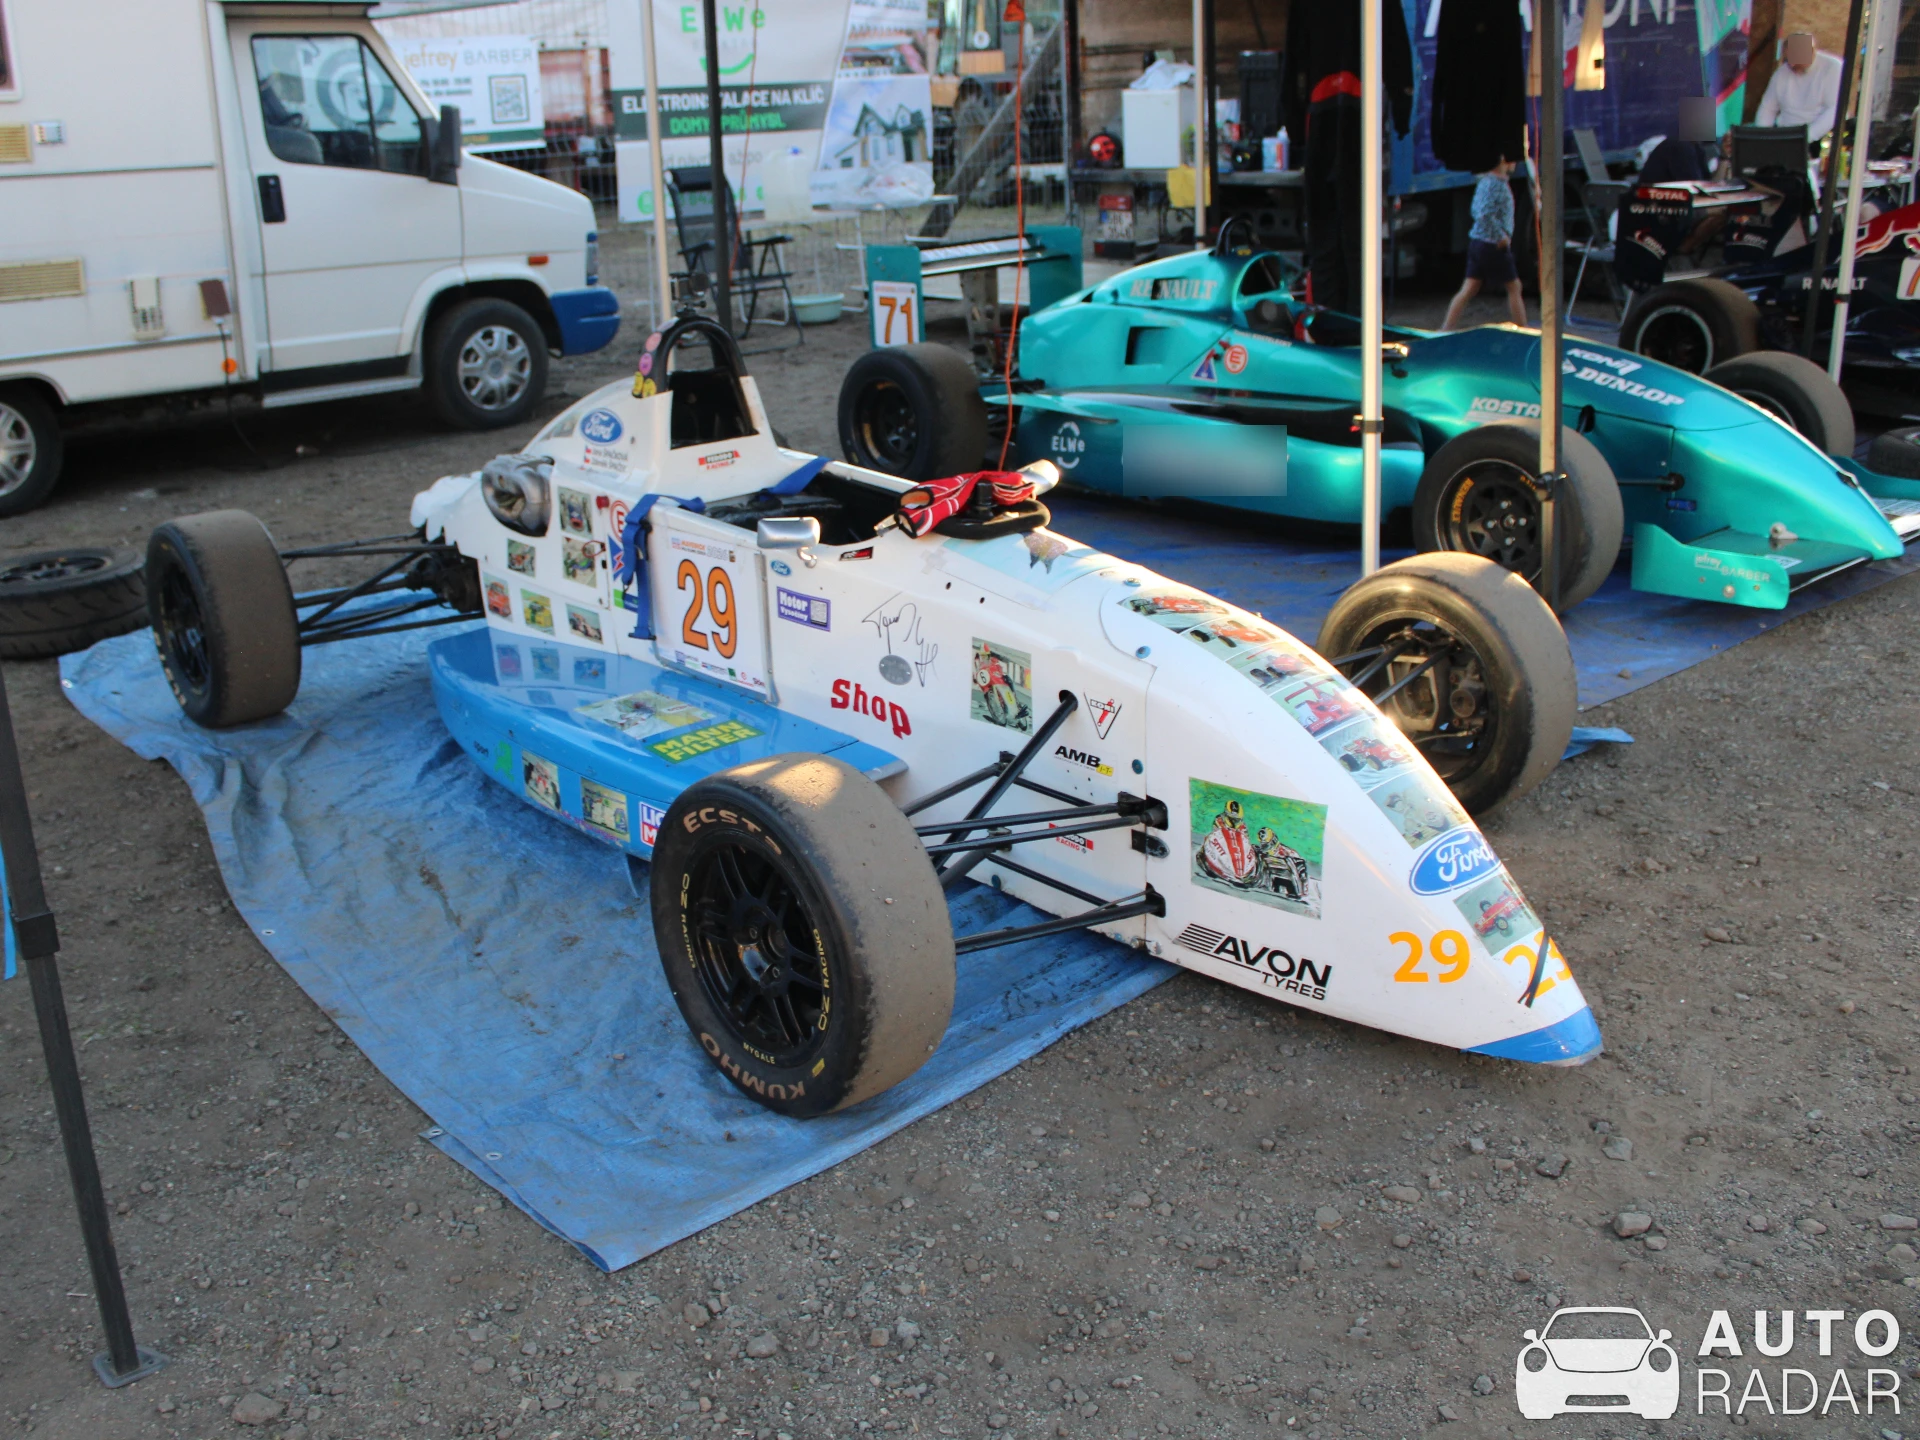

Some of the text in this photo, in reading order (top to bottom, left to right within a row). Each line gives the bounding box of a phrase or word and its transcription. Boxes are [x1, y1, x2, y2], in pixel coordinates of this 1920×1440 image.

[680, 6, 766, 33] EWe
[463, 48, 533, 66] BARBER
[1648, 189, 1688, 200] TOTAL
[1130, 278, 1217, 300] RENAULT
[879, 296, 914, 344] 71
[1575, 366, 1685, 407] DUNLOP
[1471, 396, 1542, 418] KOSTA
[585, 412, 616, 441] Ford
[1051, 436, 1086, 453] ELWe
[1721, 565, 1771, 582] BARBER
[677, 558, 738, 660] 29
[779, 591, 809, 612] Motor
[830, 678, 912, 740] Shop
[652, 721, 744, 754] MANN
[667, 727, 758, 761] FILTER
[1054, 745, 1101, 768] AMB
[1435, 834, 1495, 882] Ford
[1213, 935, 1333, 989] AVON
[1388, 929, 1471, 984] 29
[1262, 971, 1327, 1001] TYRES
[700, 1032, 806, 1101] KUMHO
[743, 1042, 776, 1065] MYGALE
